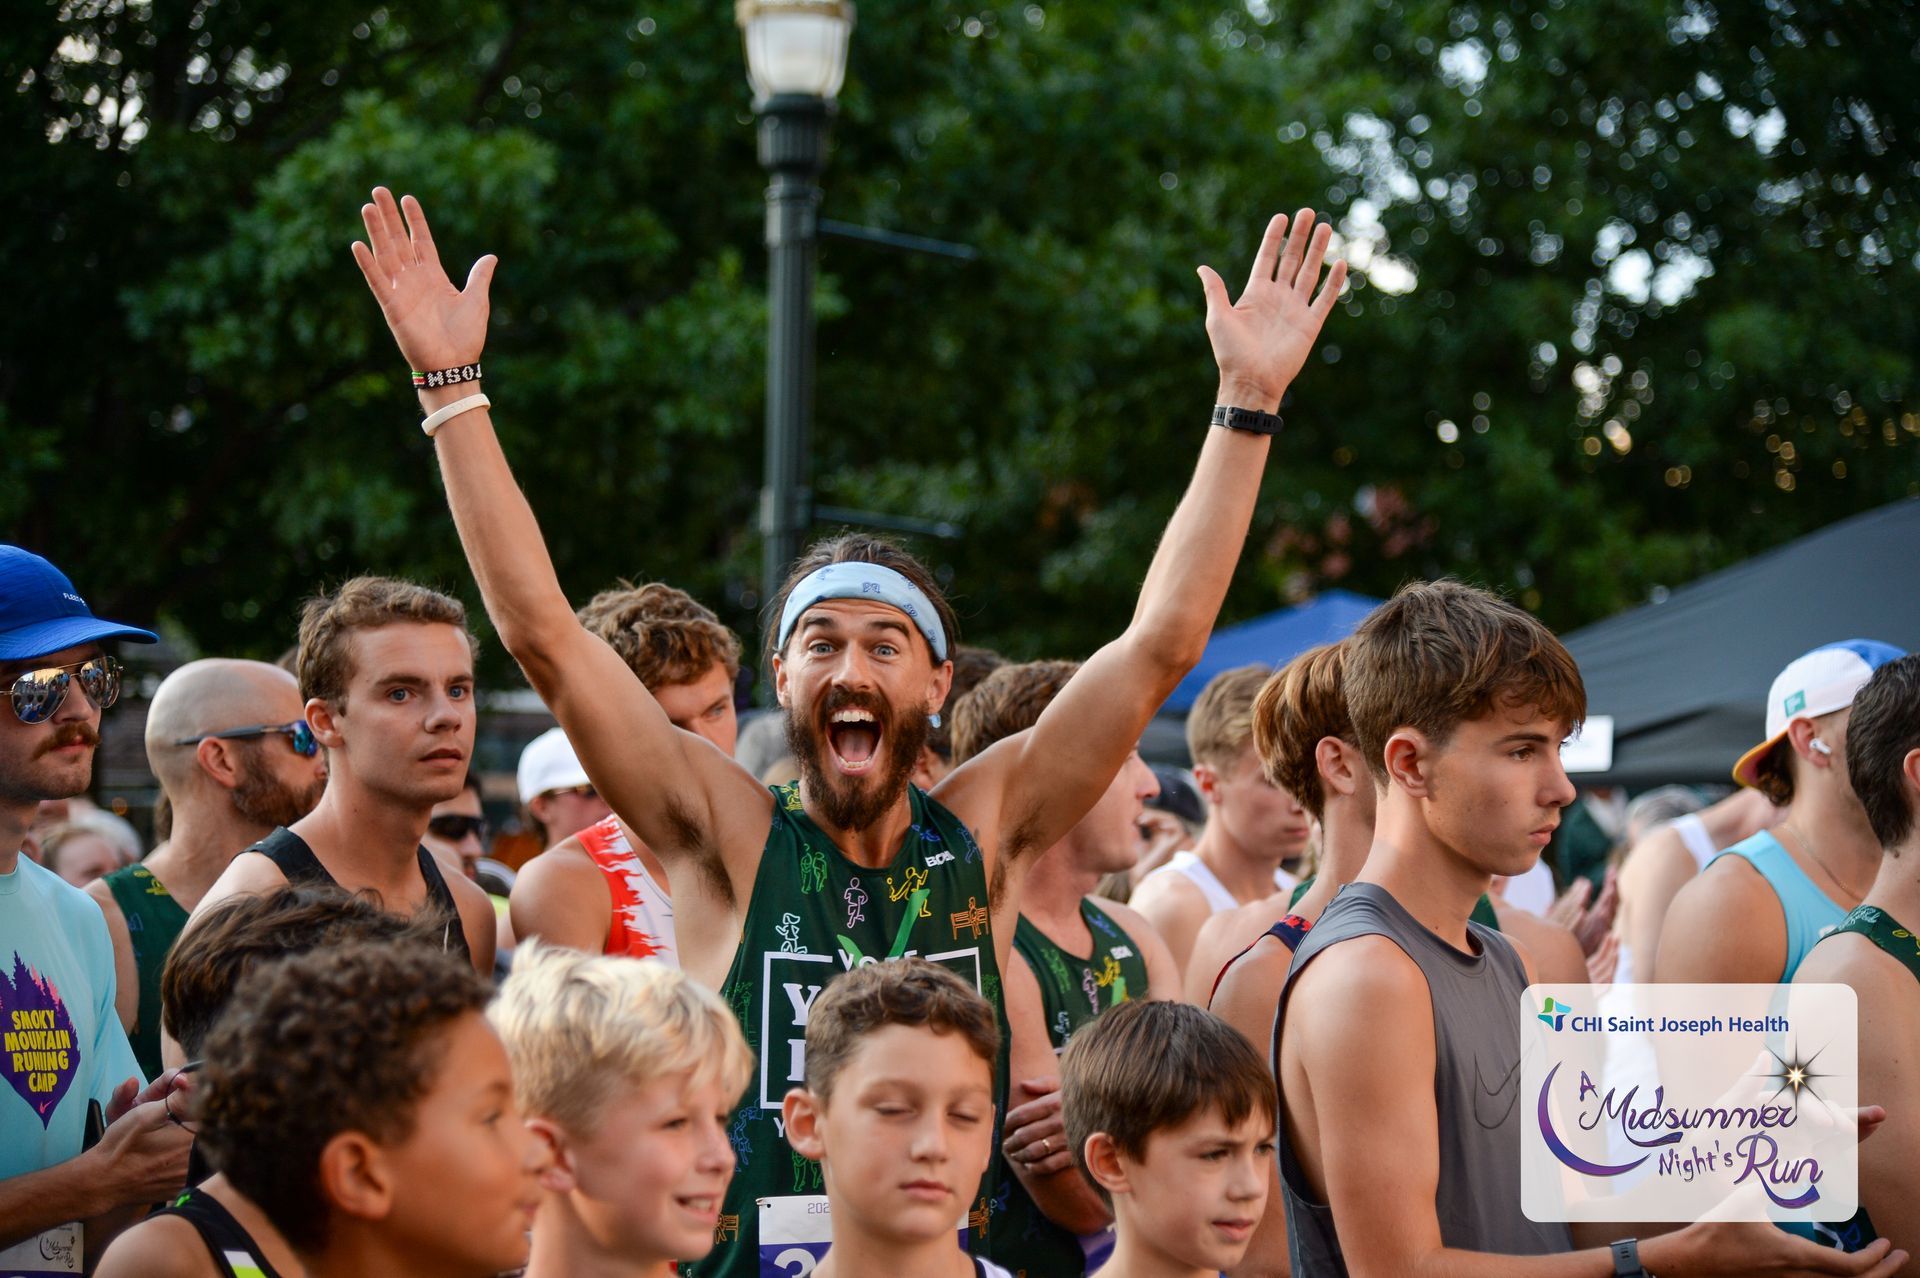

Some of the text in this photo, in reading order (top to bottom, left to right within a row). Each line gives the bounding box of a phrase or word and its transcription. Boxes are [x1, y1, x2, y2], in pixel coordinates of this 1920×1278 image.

[12, 1010, 55, 1030] SMOKY
[4, 1030, 71, 1052] MOUNTAIN
[13, 1050, 69, 1073] RUNNING
[28, 1072, 57, 1092] CAMP
[807, 1203, 831, 1214] 202
